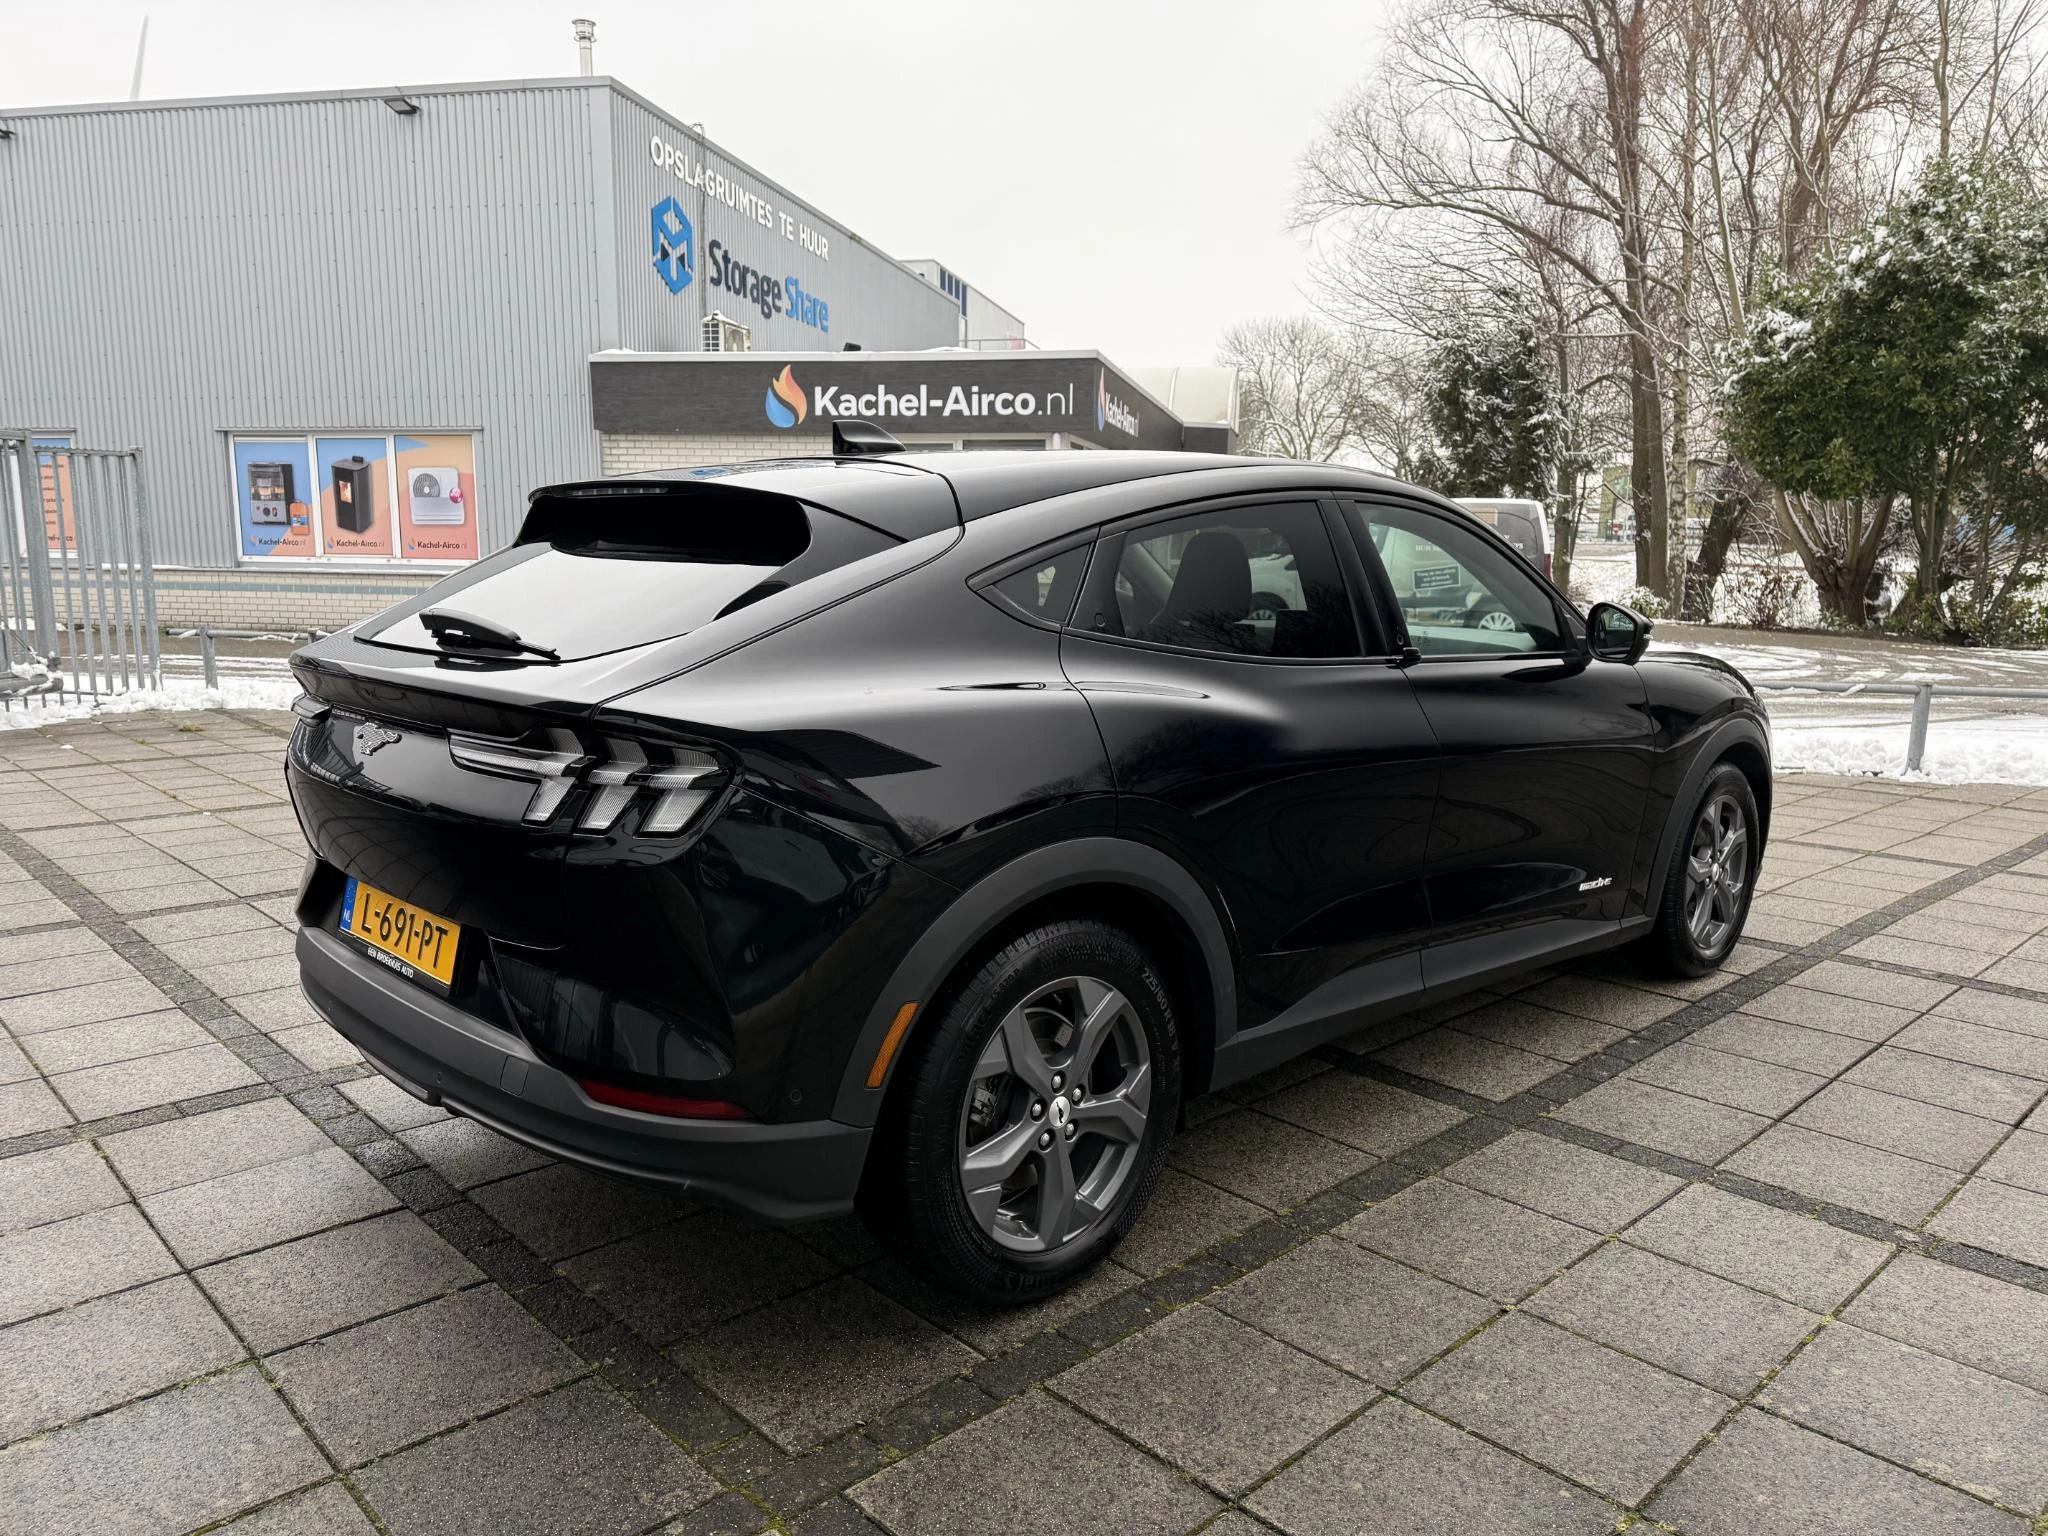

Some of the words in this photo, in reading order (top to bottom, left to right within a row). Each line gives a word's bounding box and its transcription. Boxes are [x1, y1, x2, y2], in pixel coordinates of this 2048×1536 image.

[650, 135, 772, 229] OPSLAGRUIMTES
[779, 211, 794, 241] TE
[800, 223, 829, 260] HUUR
[709, 239, 782, 319] Storage
[785, 275, 829, 333] Share
[814, 383, 1073, 417] Kachel-Airco.nl
[343, 908, 351, 923] NL
[361, 893, 448, 969] L-691-PT
[400, 967, 414, 979] AUTO
